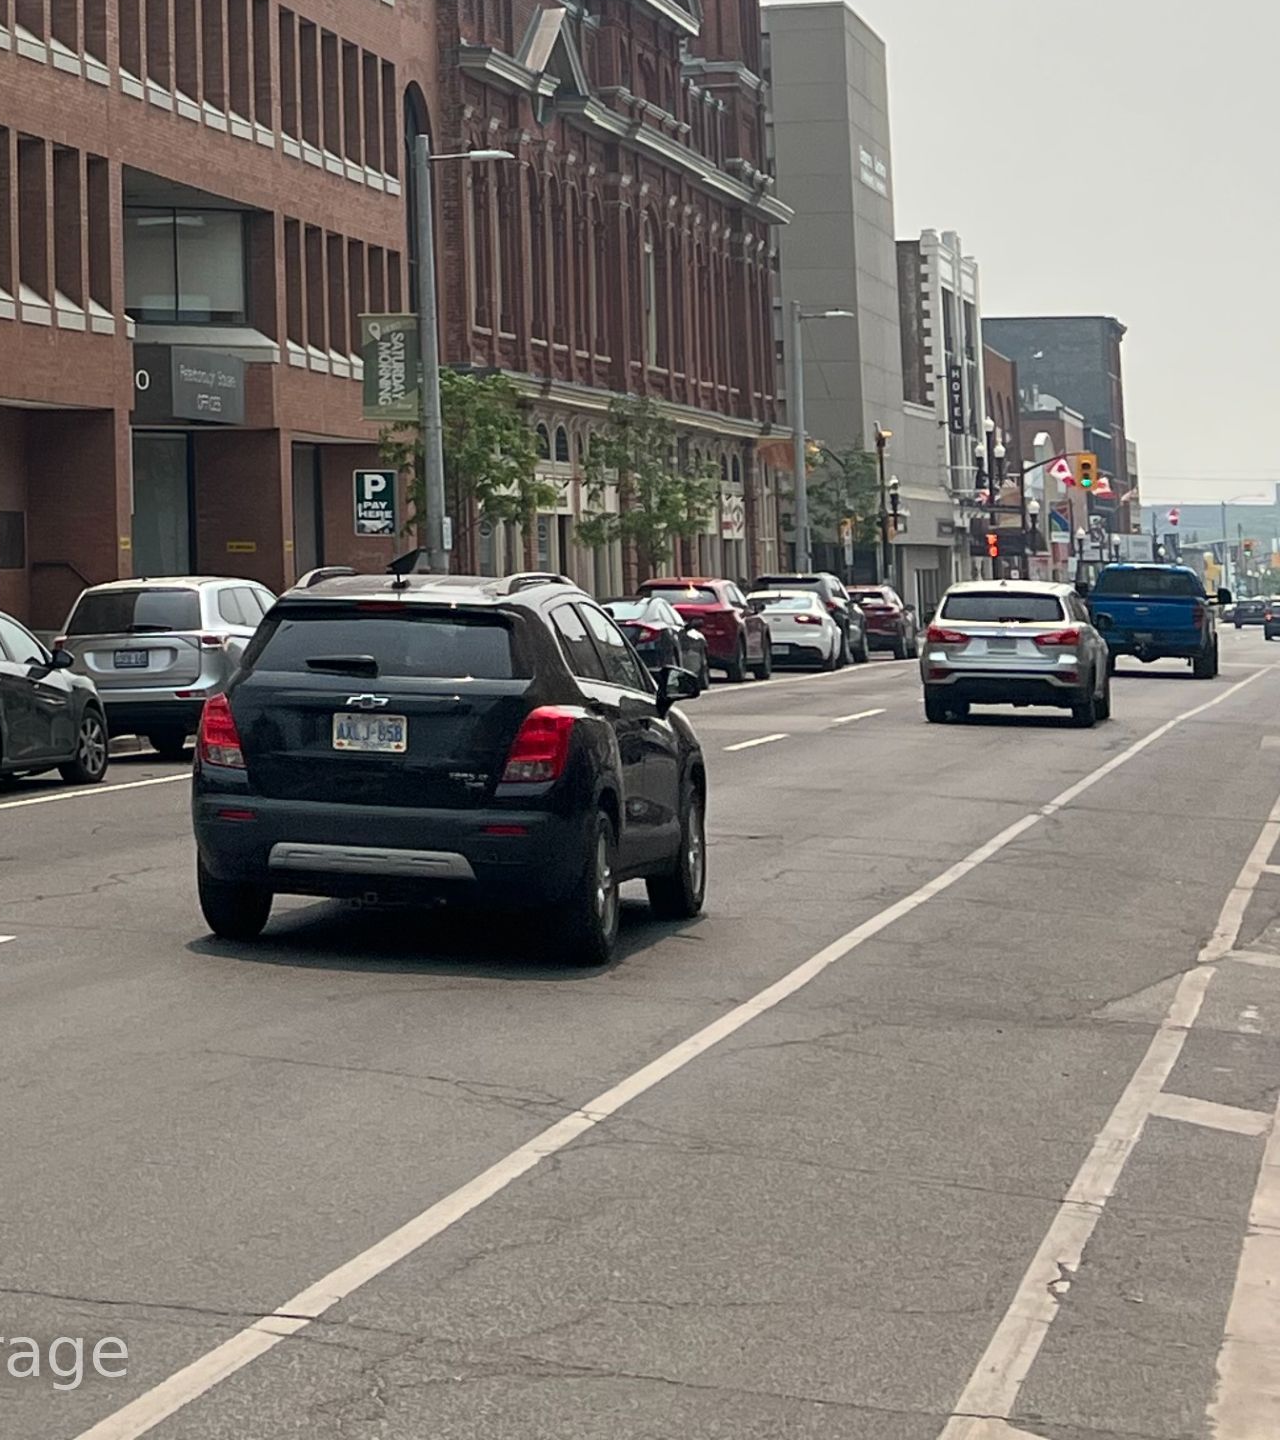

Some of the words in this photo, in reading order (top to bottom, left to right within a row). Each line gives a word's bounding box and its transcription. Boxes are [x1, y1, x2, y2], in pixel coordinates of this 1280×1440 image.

[378, 342, 392, 405] MORNING
[391, 332, 405, 399] SATURDAY
[951, 369, 961, 429] HOTEL
[363, 501, 388, 509] PAY
[364, 474, 386, 500] P
